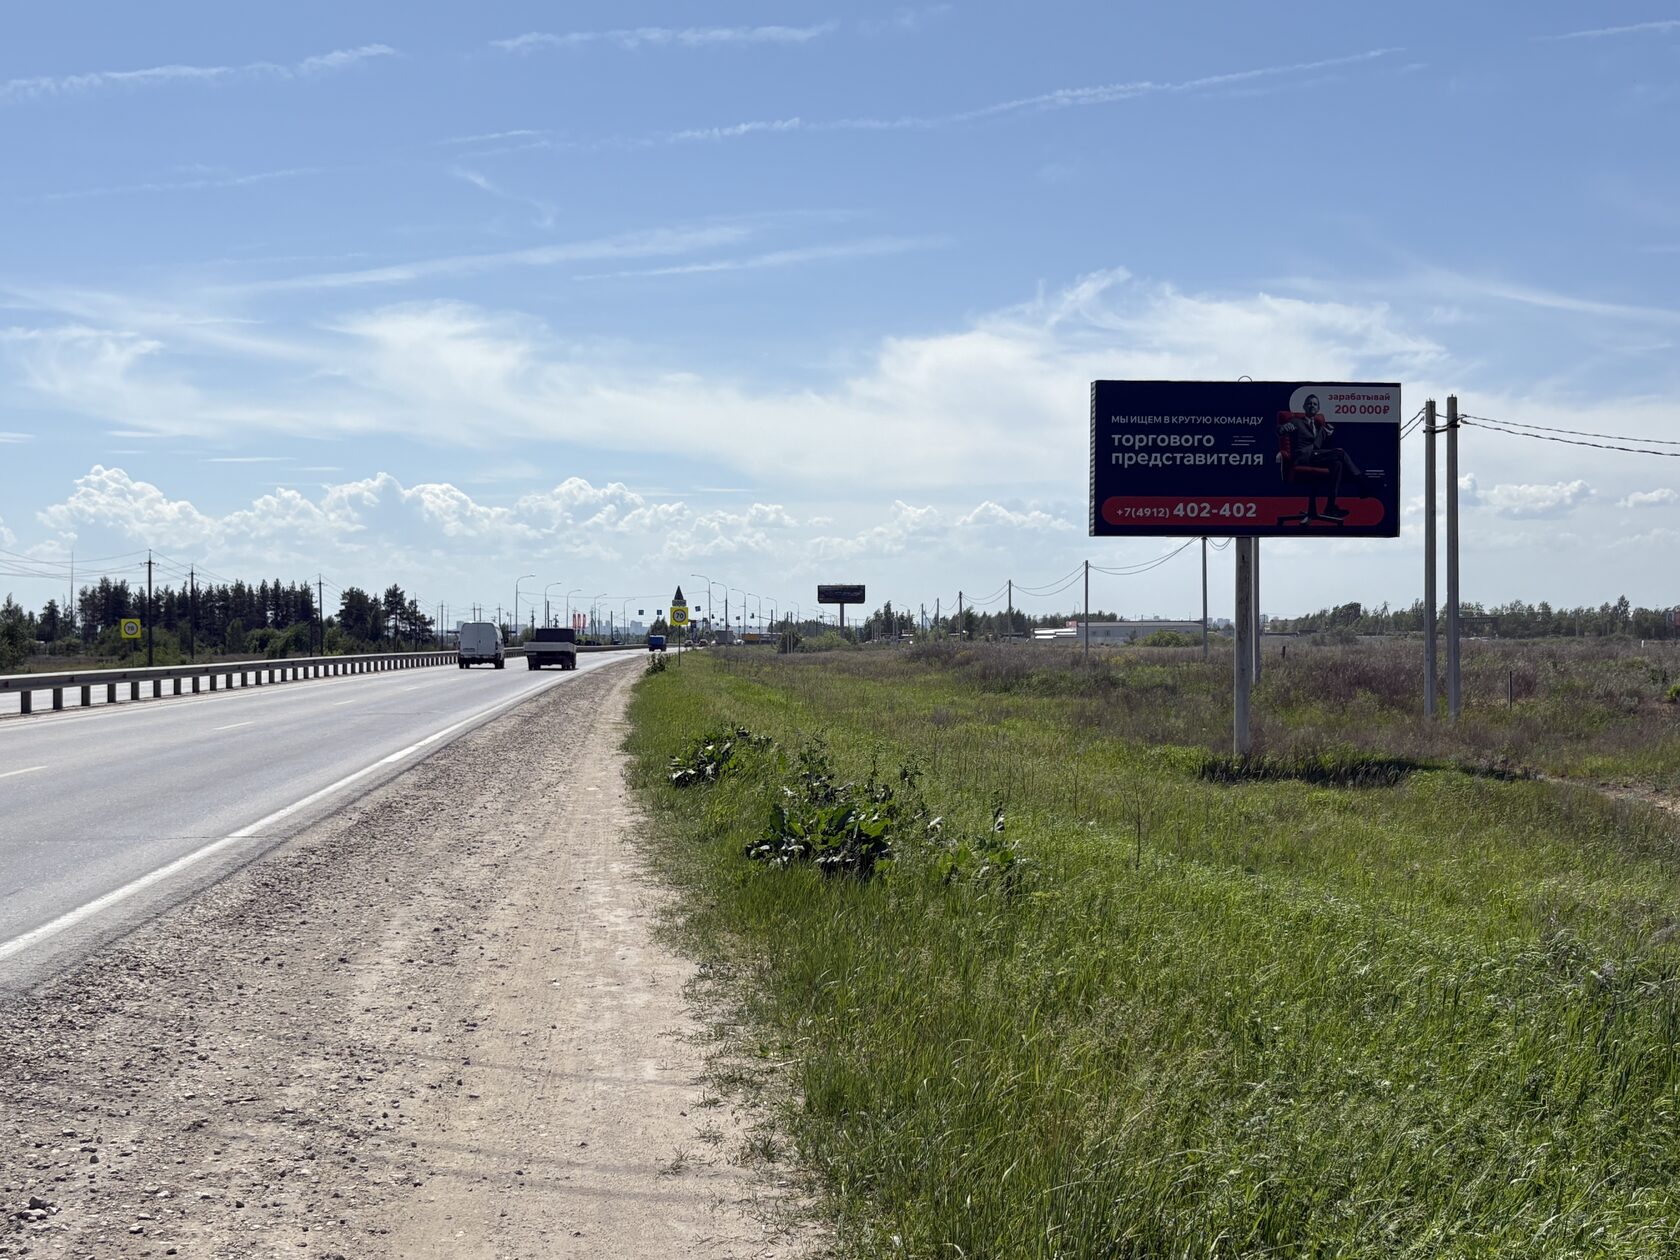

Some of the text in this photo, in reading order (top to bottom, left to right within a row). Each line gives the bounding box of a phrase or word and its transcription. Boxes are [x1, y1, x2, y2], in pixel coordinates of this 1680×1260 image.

[1328, 393, 1391, 401] зарабатывай
[1335, 405, 1357, 414] 200
[1111, 416, 1264, 426] МЫ ИЩЕМ В КРУТУЮ КОМАНДУ
[1111, 434, 1215, 450] торгового
[1111, 453, 1264, 468] представителя
[1116, 502, 1257, 519] +7(4912) 402-402
